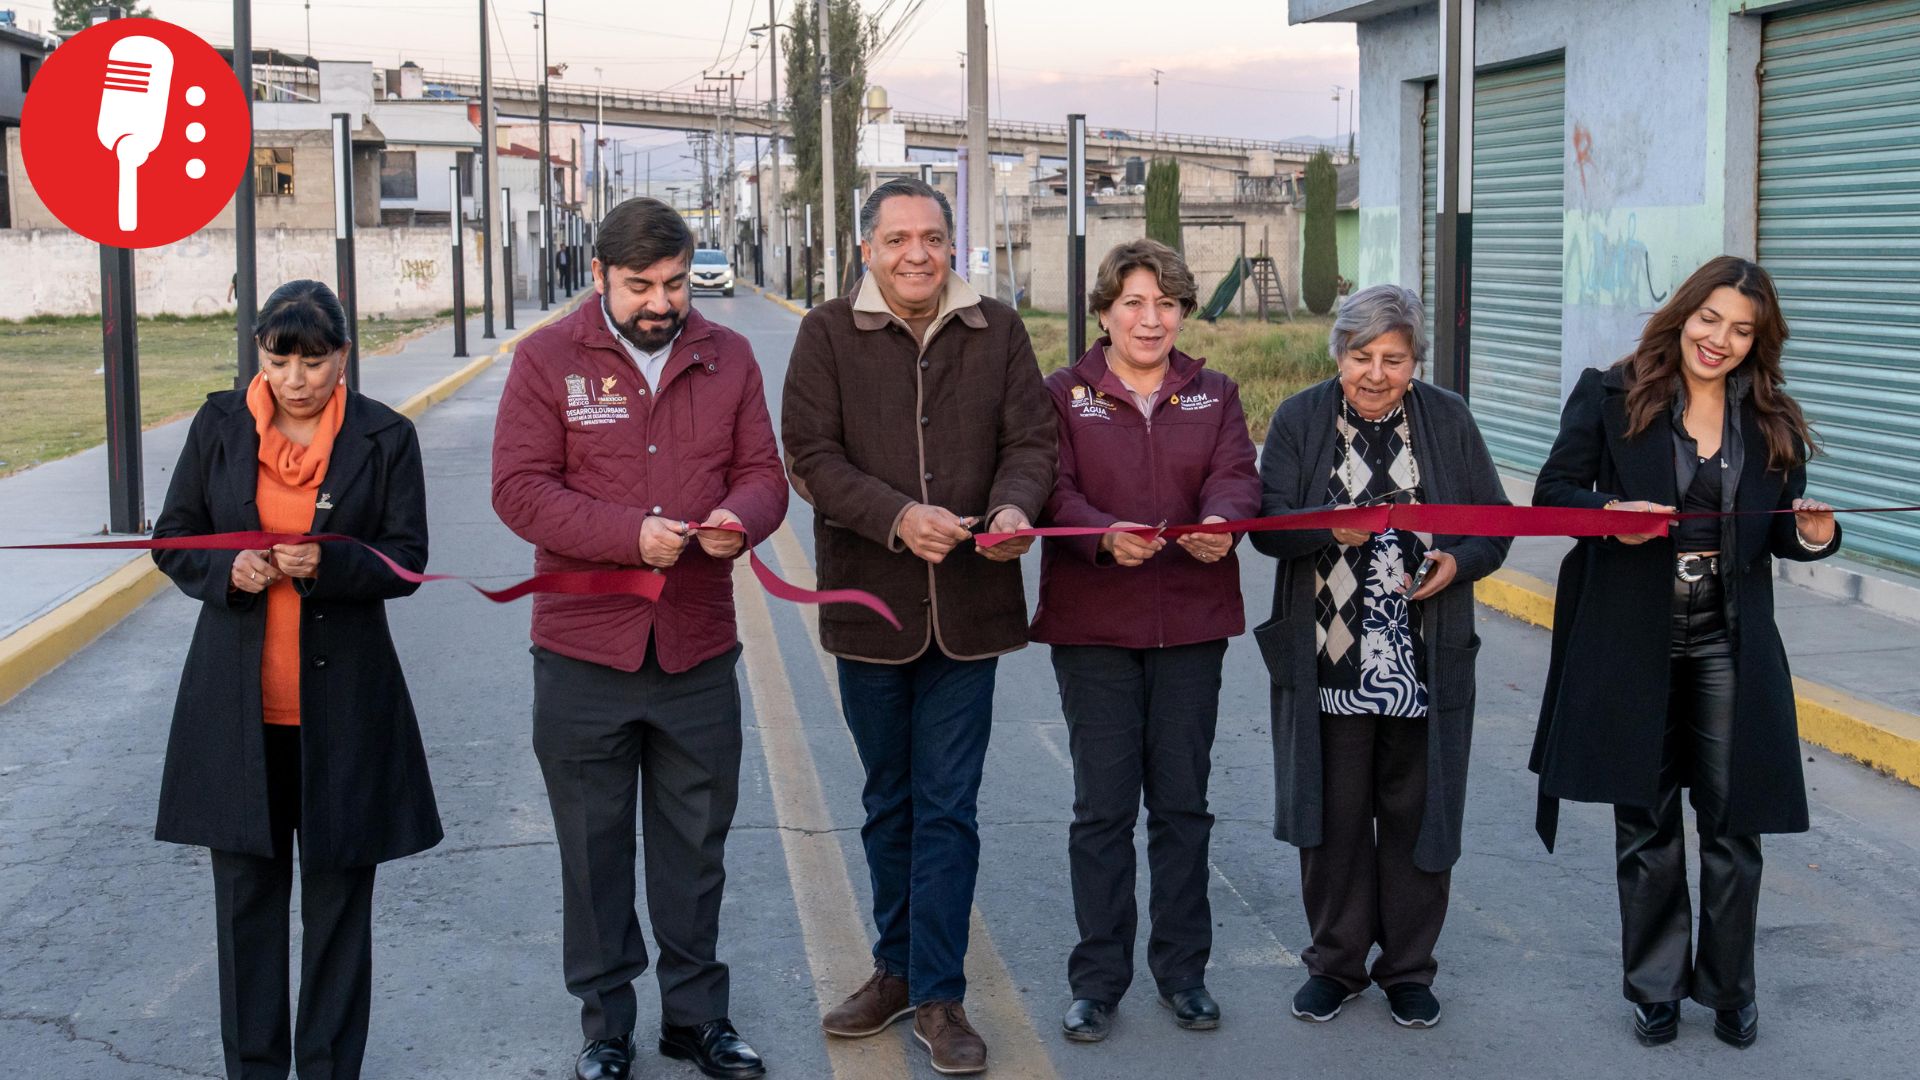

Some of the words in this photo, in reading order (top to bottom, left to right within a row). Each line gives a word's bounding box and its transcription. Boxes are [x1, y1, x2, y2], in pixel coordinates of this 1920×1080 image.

[1180, 393, 1207, 403] CAEM
[566, 408, 603, 417] DESARROLLO
[1083, 406, 1107, 415] AGUA
